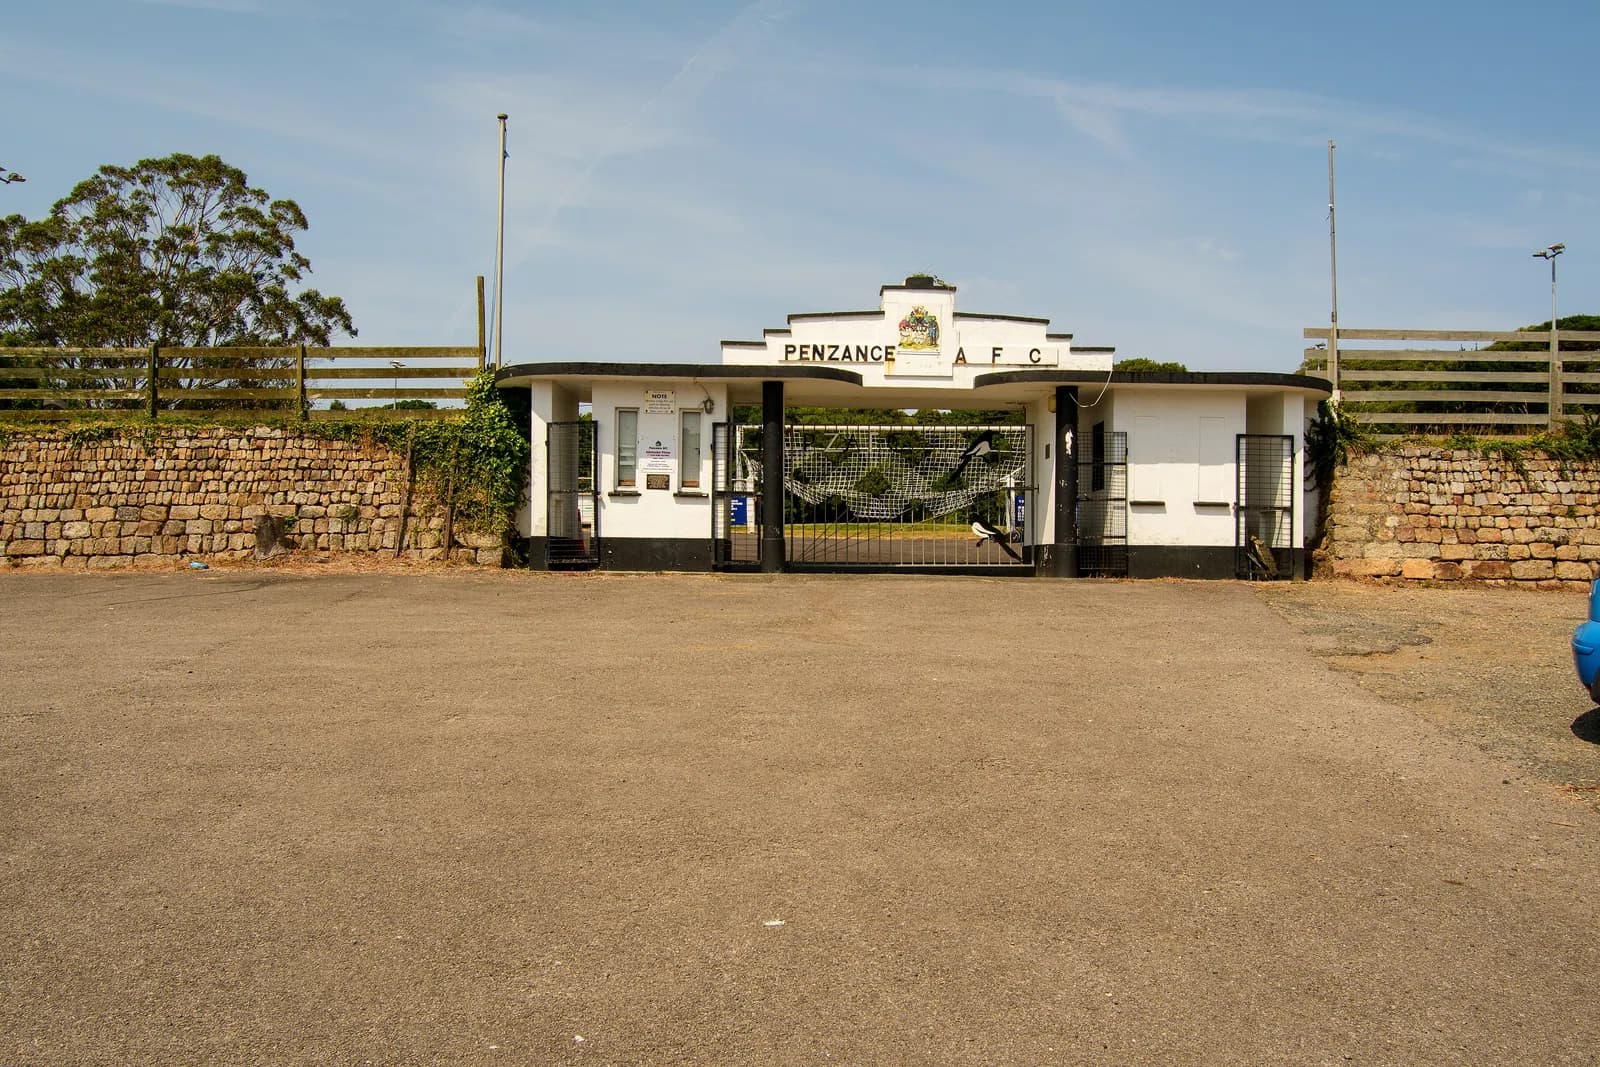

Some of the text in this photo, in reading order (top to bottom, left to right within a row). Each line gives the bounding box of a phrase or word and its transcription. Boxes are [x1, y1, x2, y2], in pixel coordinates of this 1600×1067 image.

[785, 345, 1042, 364] PENZANCE A F C
